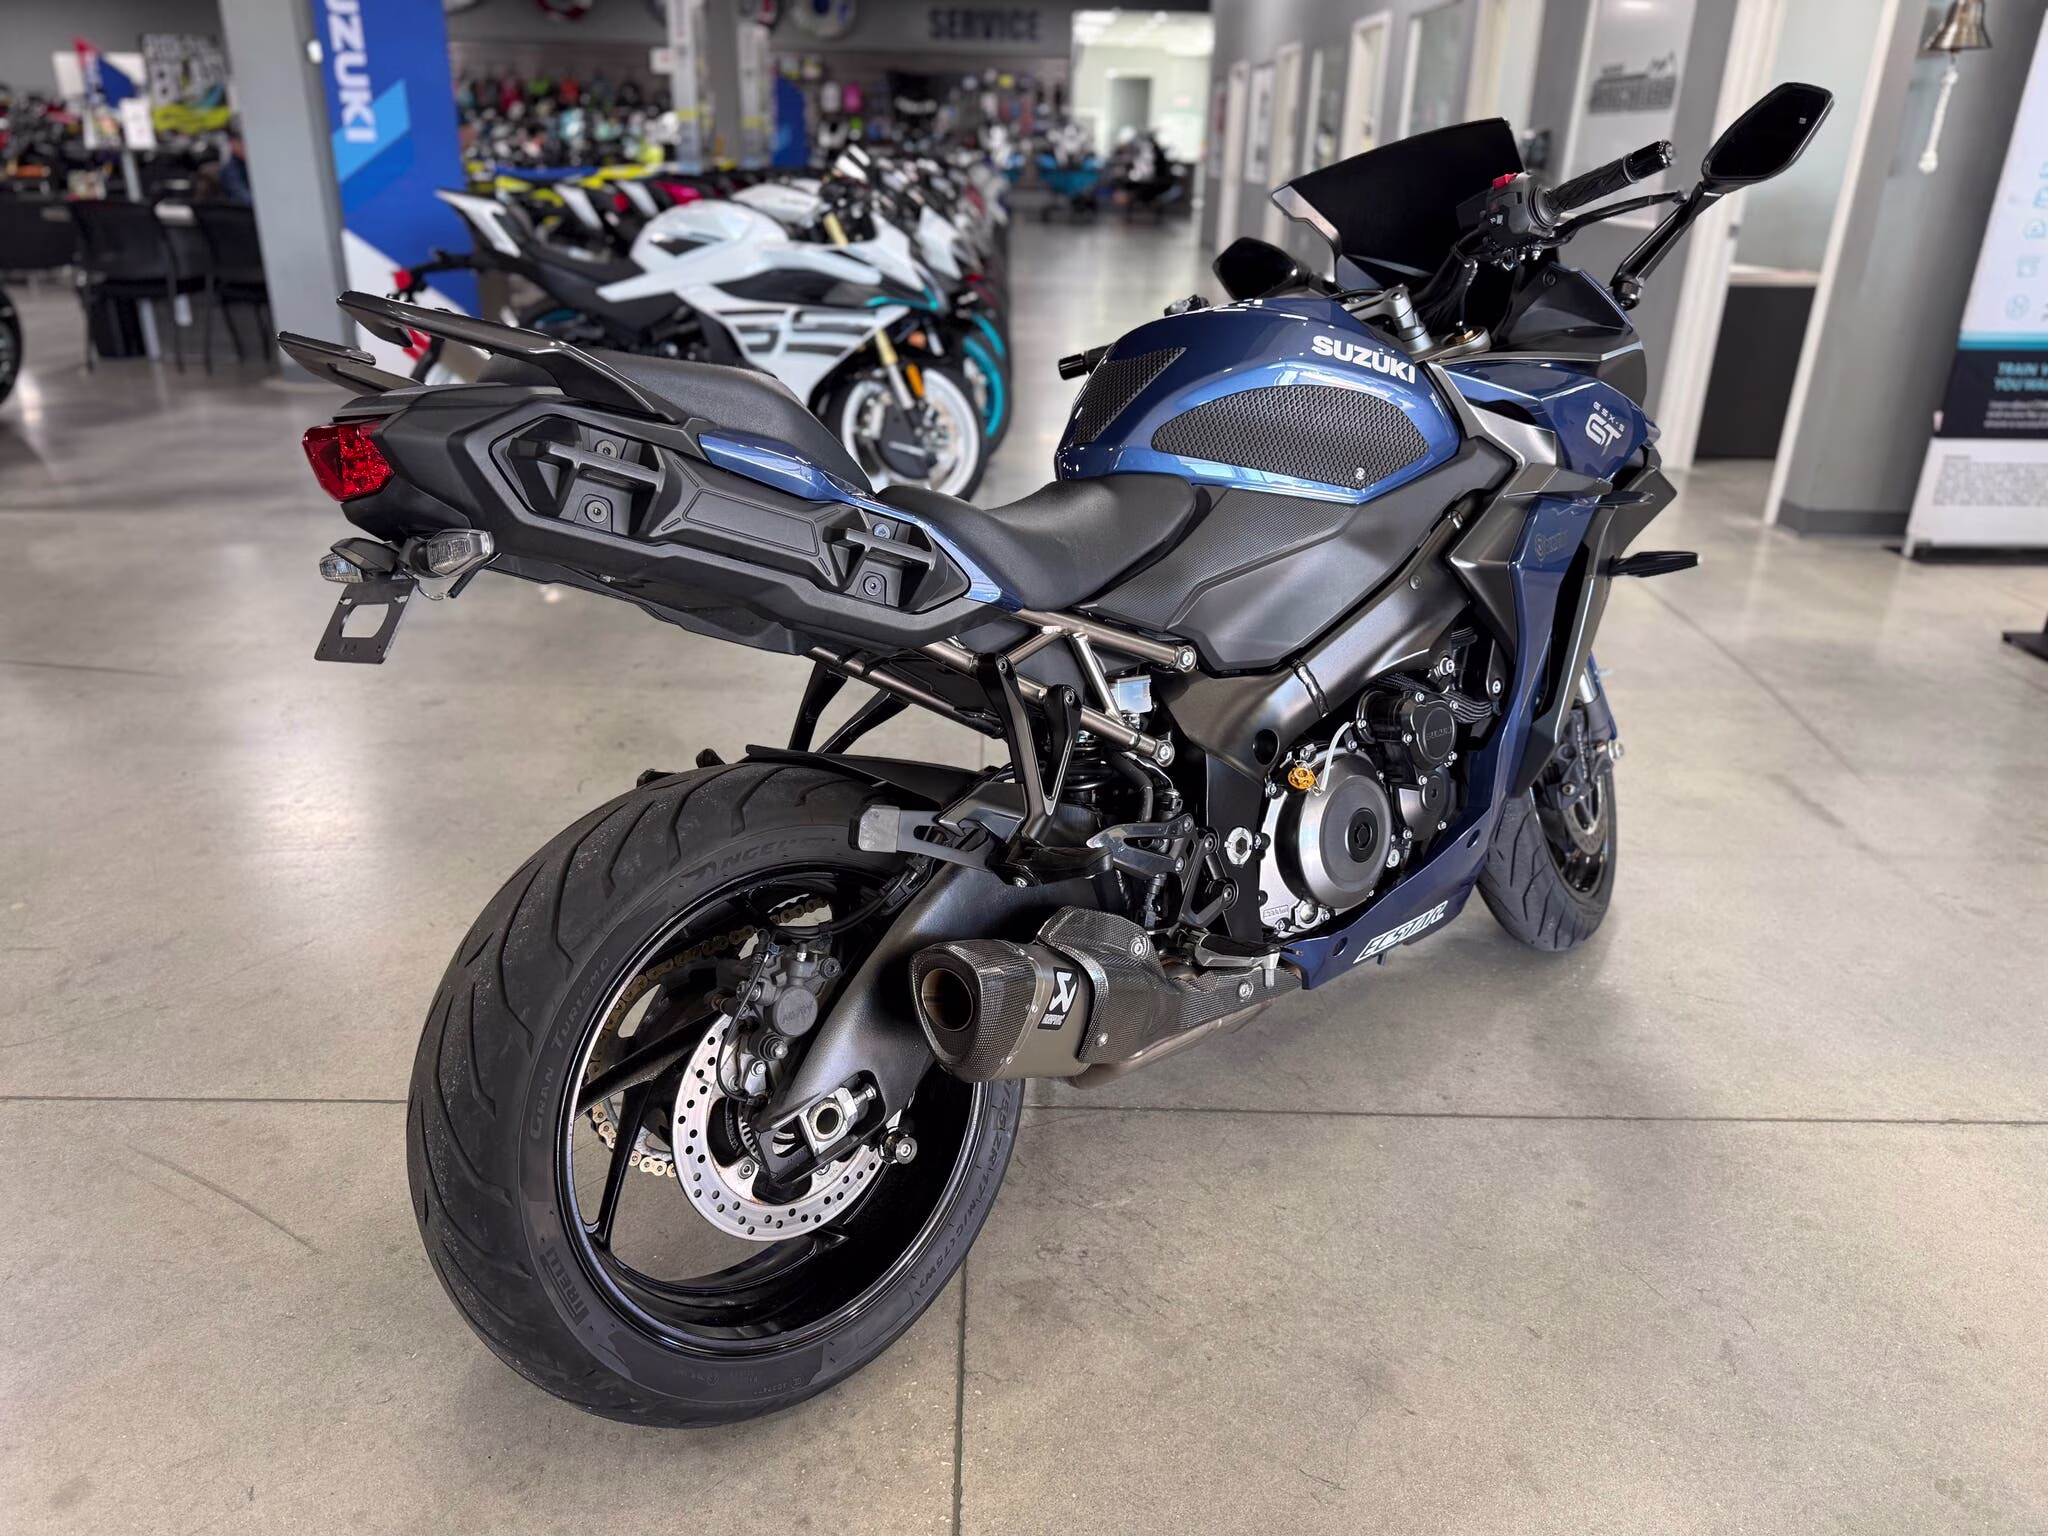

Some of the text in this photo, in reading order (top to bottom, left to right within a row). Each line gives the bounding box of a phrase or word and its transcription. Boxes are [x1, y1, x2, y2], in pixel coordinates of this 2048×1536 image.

[928, 8, 1040, 41] SERVICE
[1311, 335, 1416, 385] SUZUKI
[1585, 413, 1622, 456] GT
[1353, 900, 1449, 964] ECSTAR
[539, 1246, 591, 1327] PIRELLI
